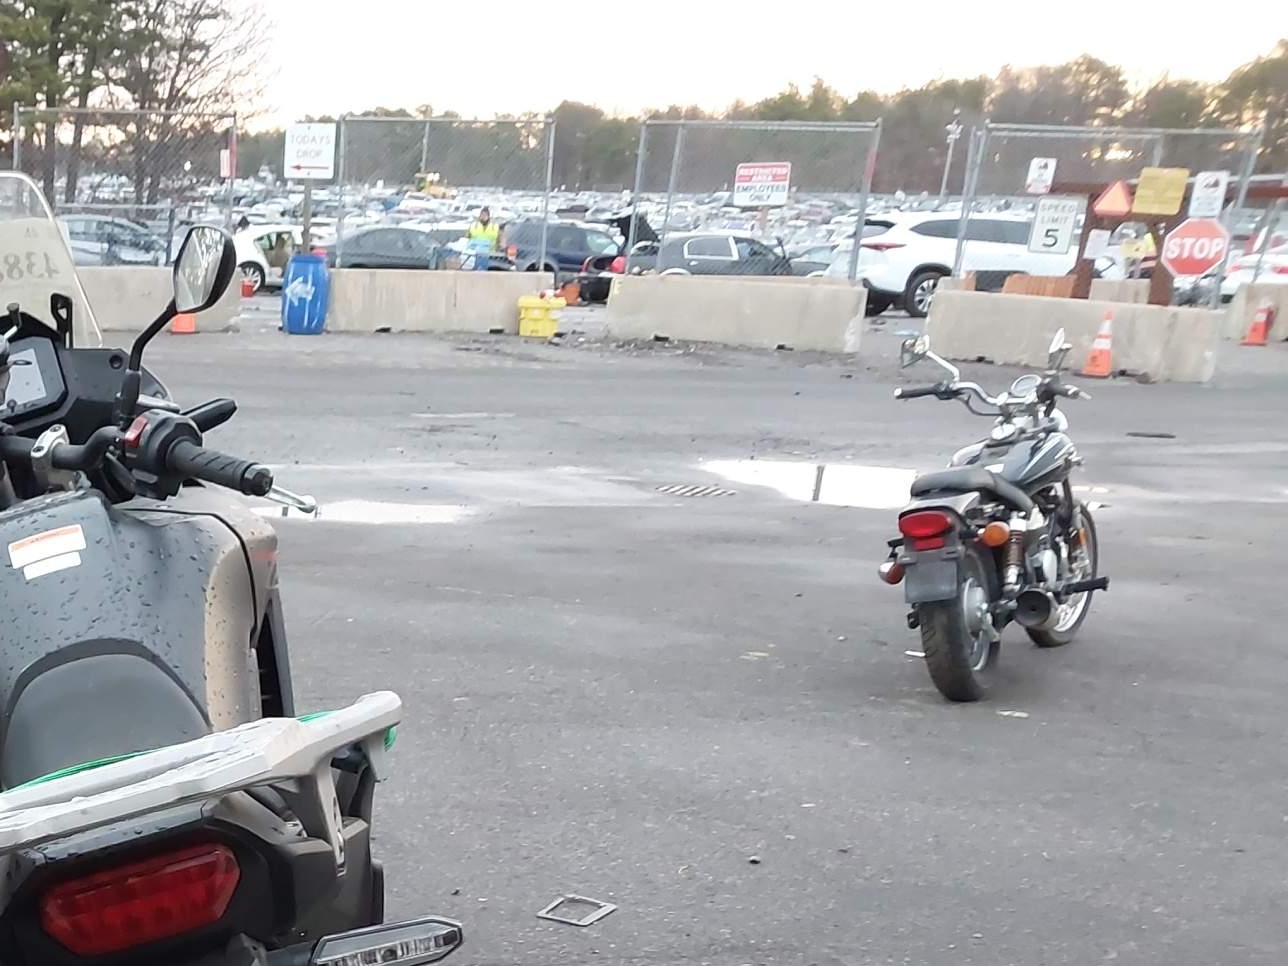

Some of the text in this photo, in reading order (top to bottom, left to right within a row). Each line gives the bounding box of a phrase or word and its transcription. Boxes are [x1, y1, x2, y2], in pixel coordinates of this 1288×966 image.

[291, 134, 331, 145] TODAYS
[739, 167, 788, 176] RESTRICTED
[736, 185, 786, 193] EMPLOYEES
[1041, 203, 1076, 213] SPEED
[1041, 215, 1070, 225] LIMIT
[1042, 228, 1060, 248] 5
[1166, 237, 1224, 260] STOP
